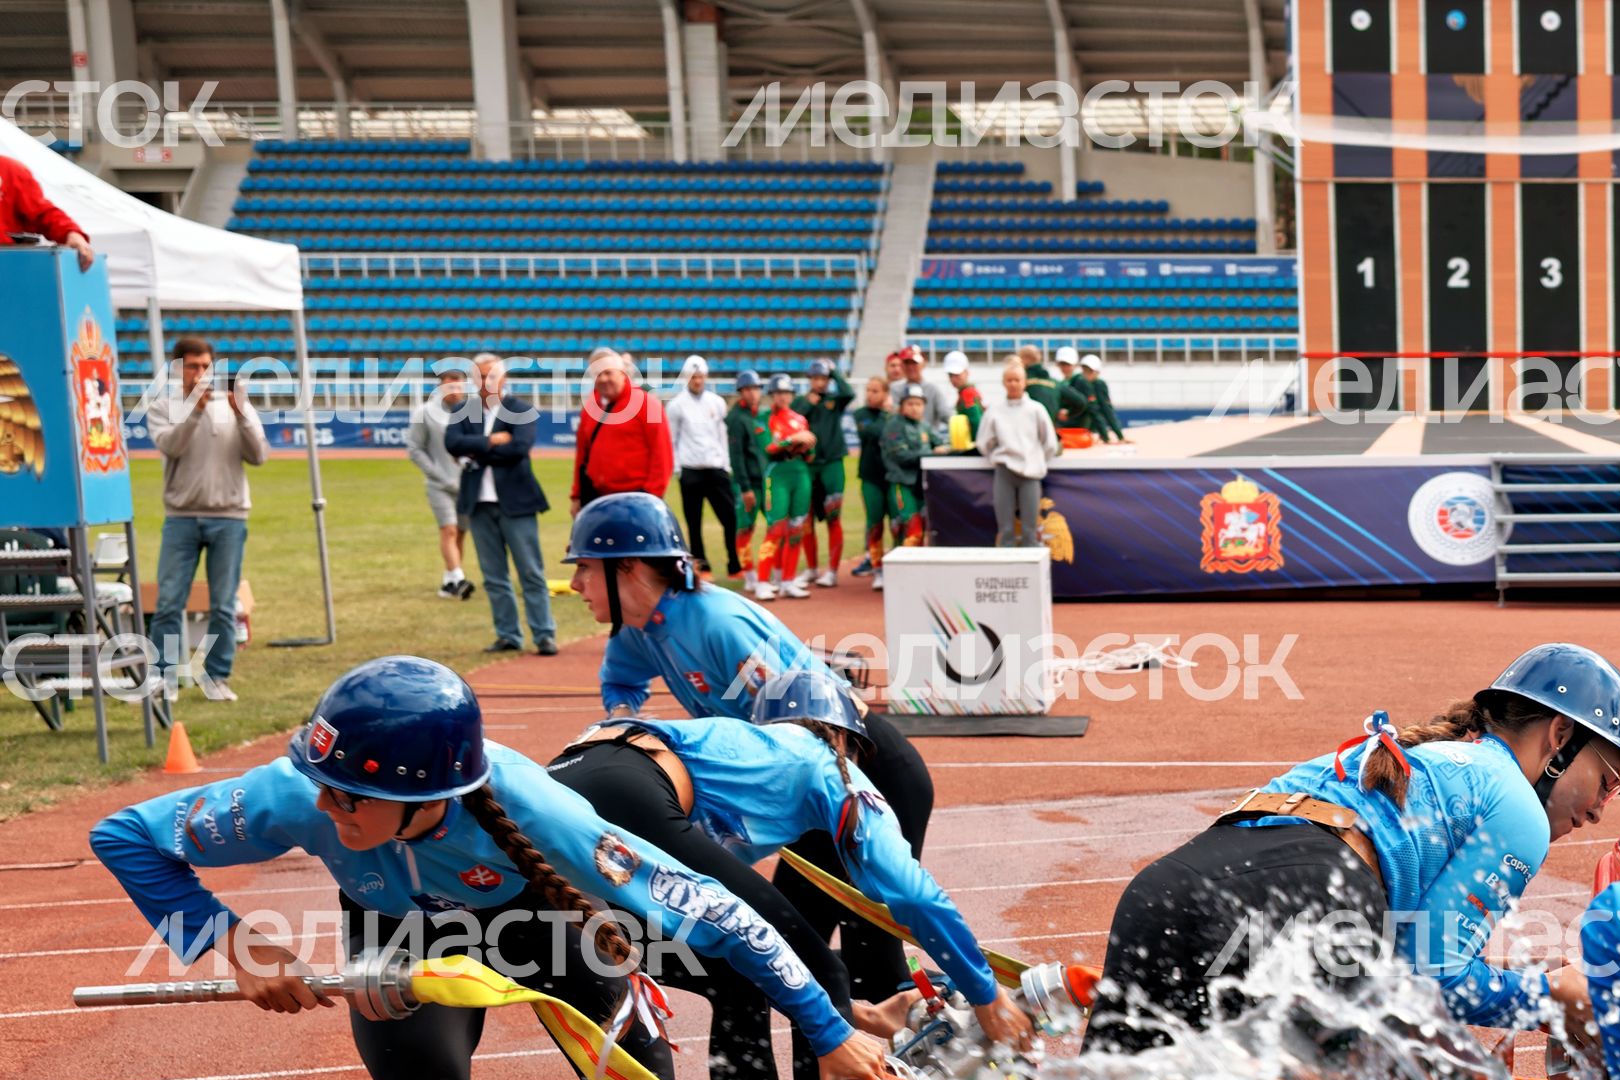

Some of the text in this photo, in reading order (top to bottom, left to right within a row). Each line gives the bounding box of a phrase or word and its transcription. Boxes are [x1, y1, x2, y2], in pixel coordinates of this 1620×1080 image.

[1356, 257, 1377, 288] 1
[1446, 257, 1470, 289] 2
[1539, 257, 1564, 289] 3
[975, 577, 1030, 590] БУДУЩЕЕ
[975, 591, 1019, 604] ВМЕСТЕ
